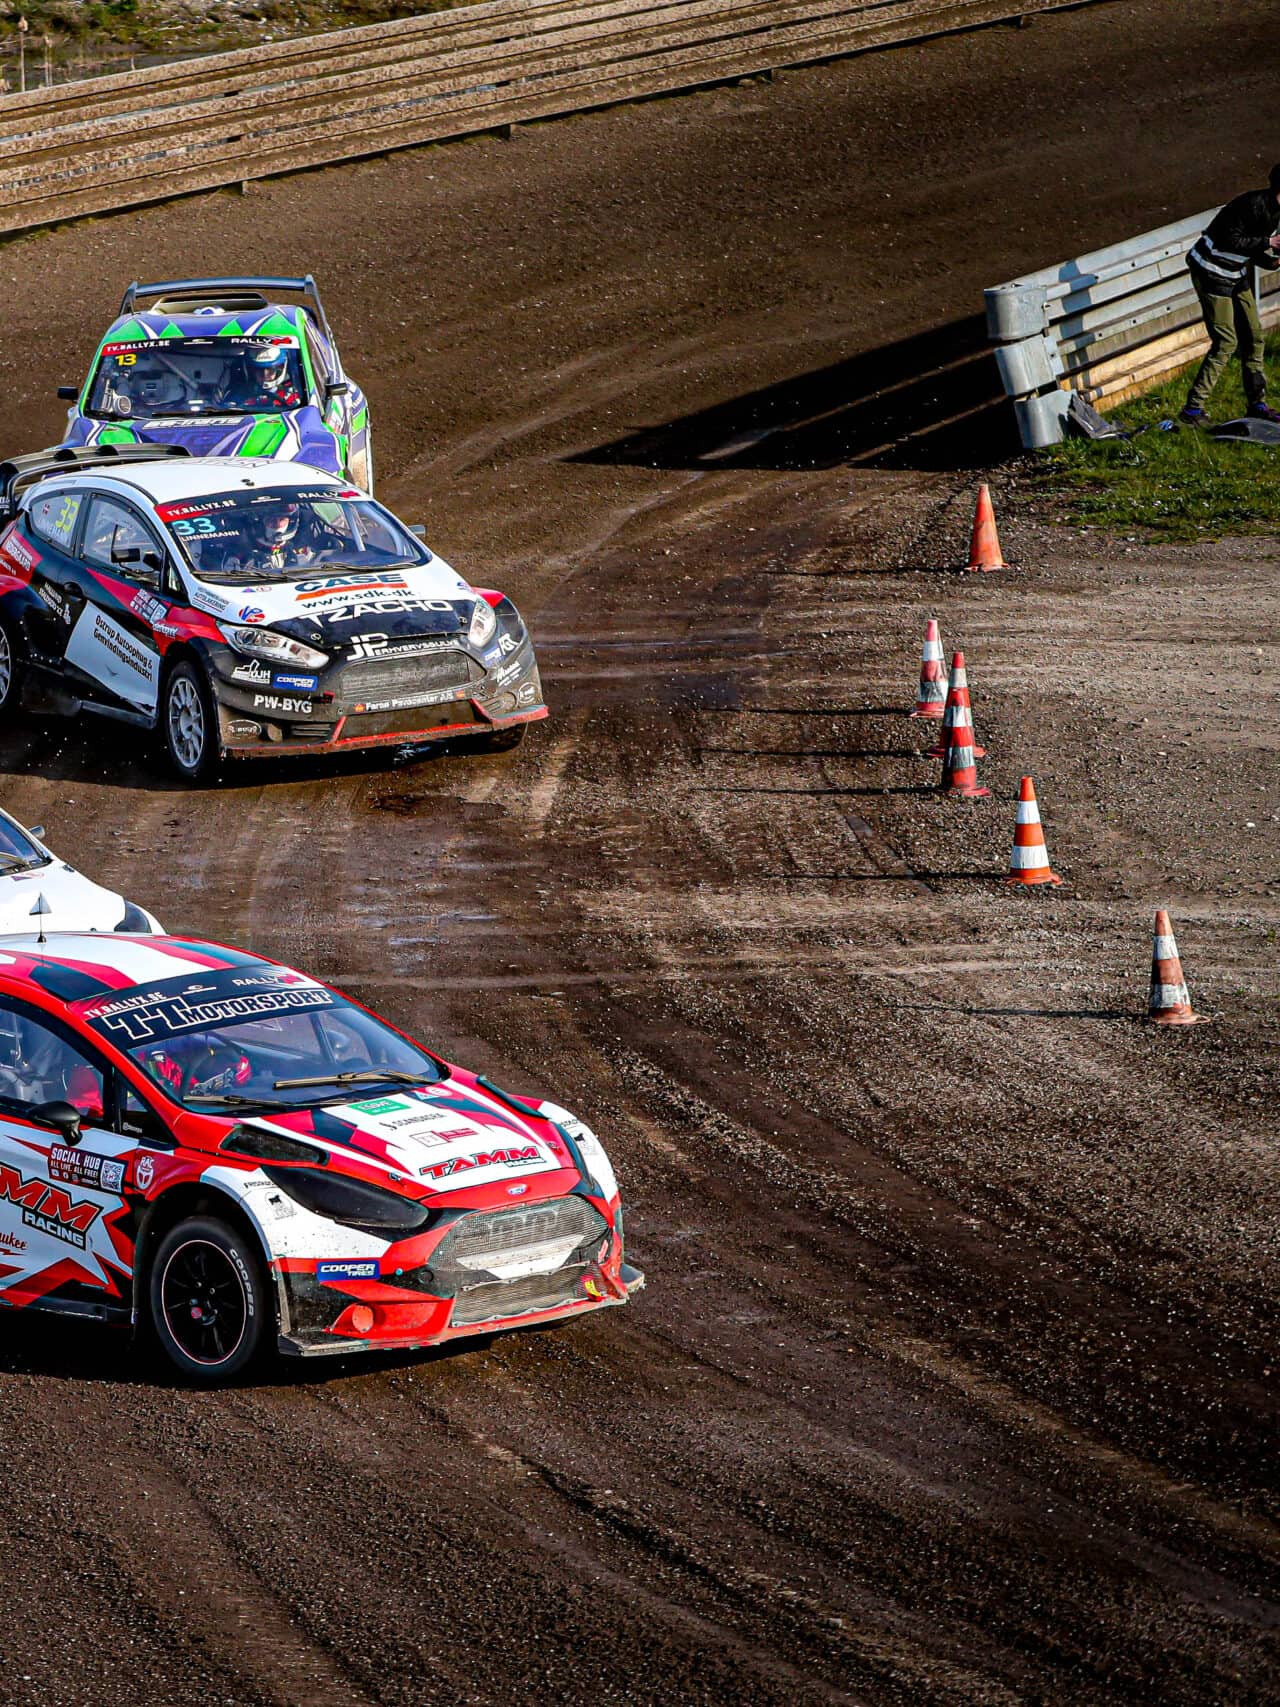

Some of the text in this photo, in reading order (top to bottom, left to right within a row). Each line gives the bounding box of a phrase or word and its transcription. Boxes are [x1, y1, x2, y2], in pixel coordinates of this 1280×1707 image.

[115, 353, 137, 367] 13
[55, 496, 80, 532] 33
[171, 517, 217, 536] 33
[294, 573, 404, 592] CASE
[299, 599, 454, 629] TZACHO
[253, 694, 313, 714] PW-BYG
[178, 988, 334, 1027] MOTORSPORT
[50, 1147, 101, 1169] SOCIAL HUB
[50, 1160, 60, 1169] ALL
[73, 1166, 83, 1175] ALL
[419, 1145, 541, 1181] TAMM
[24, 1210, 84, 1247] RACING
[320, 1263, 376, 1273] COOPER
[230, 1248, 255, 1317] COOPER
